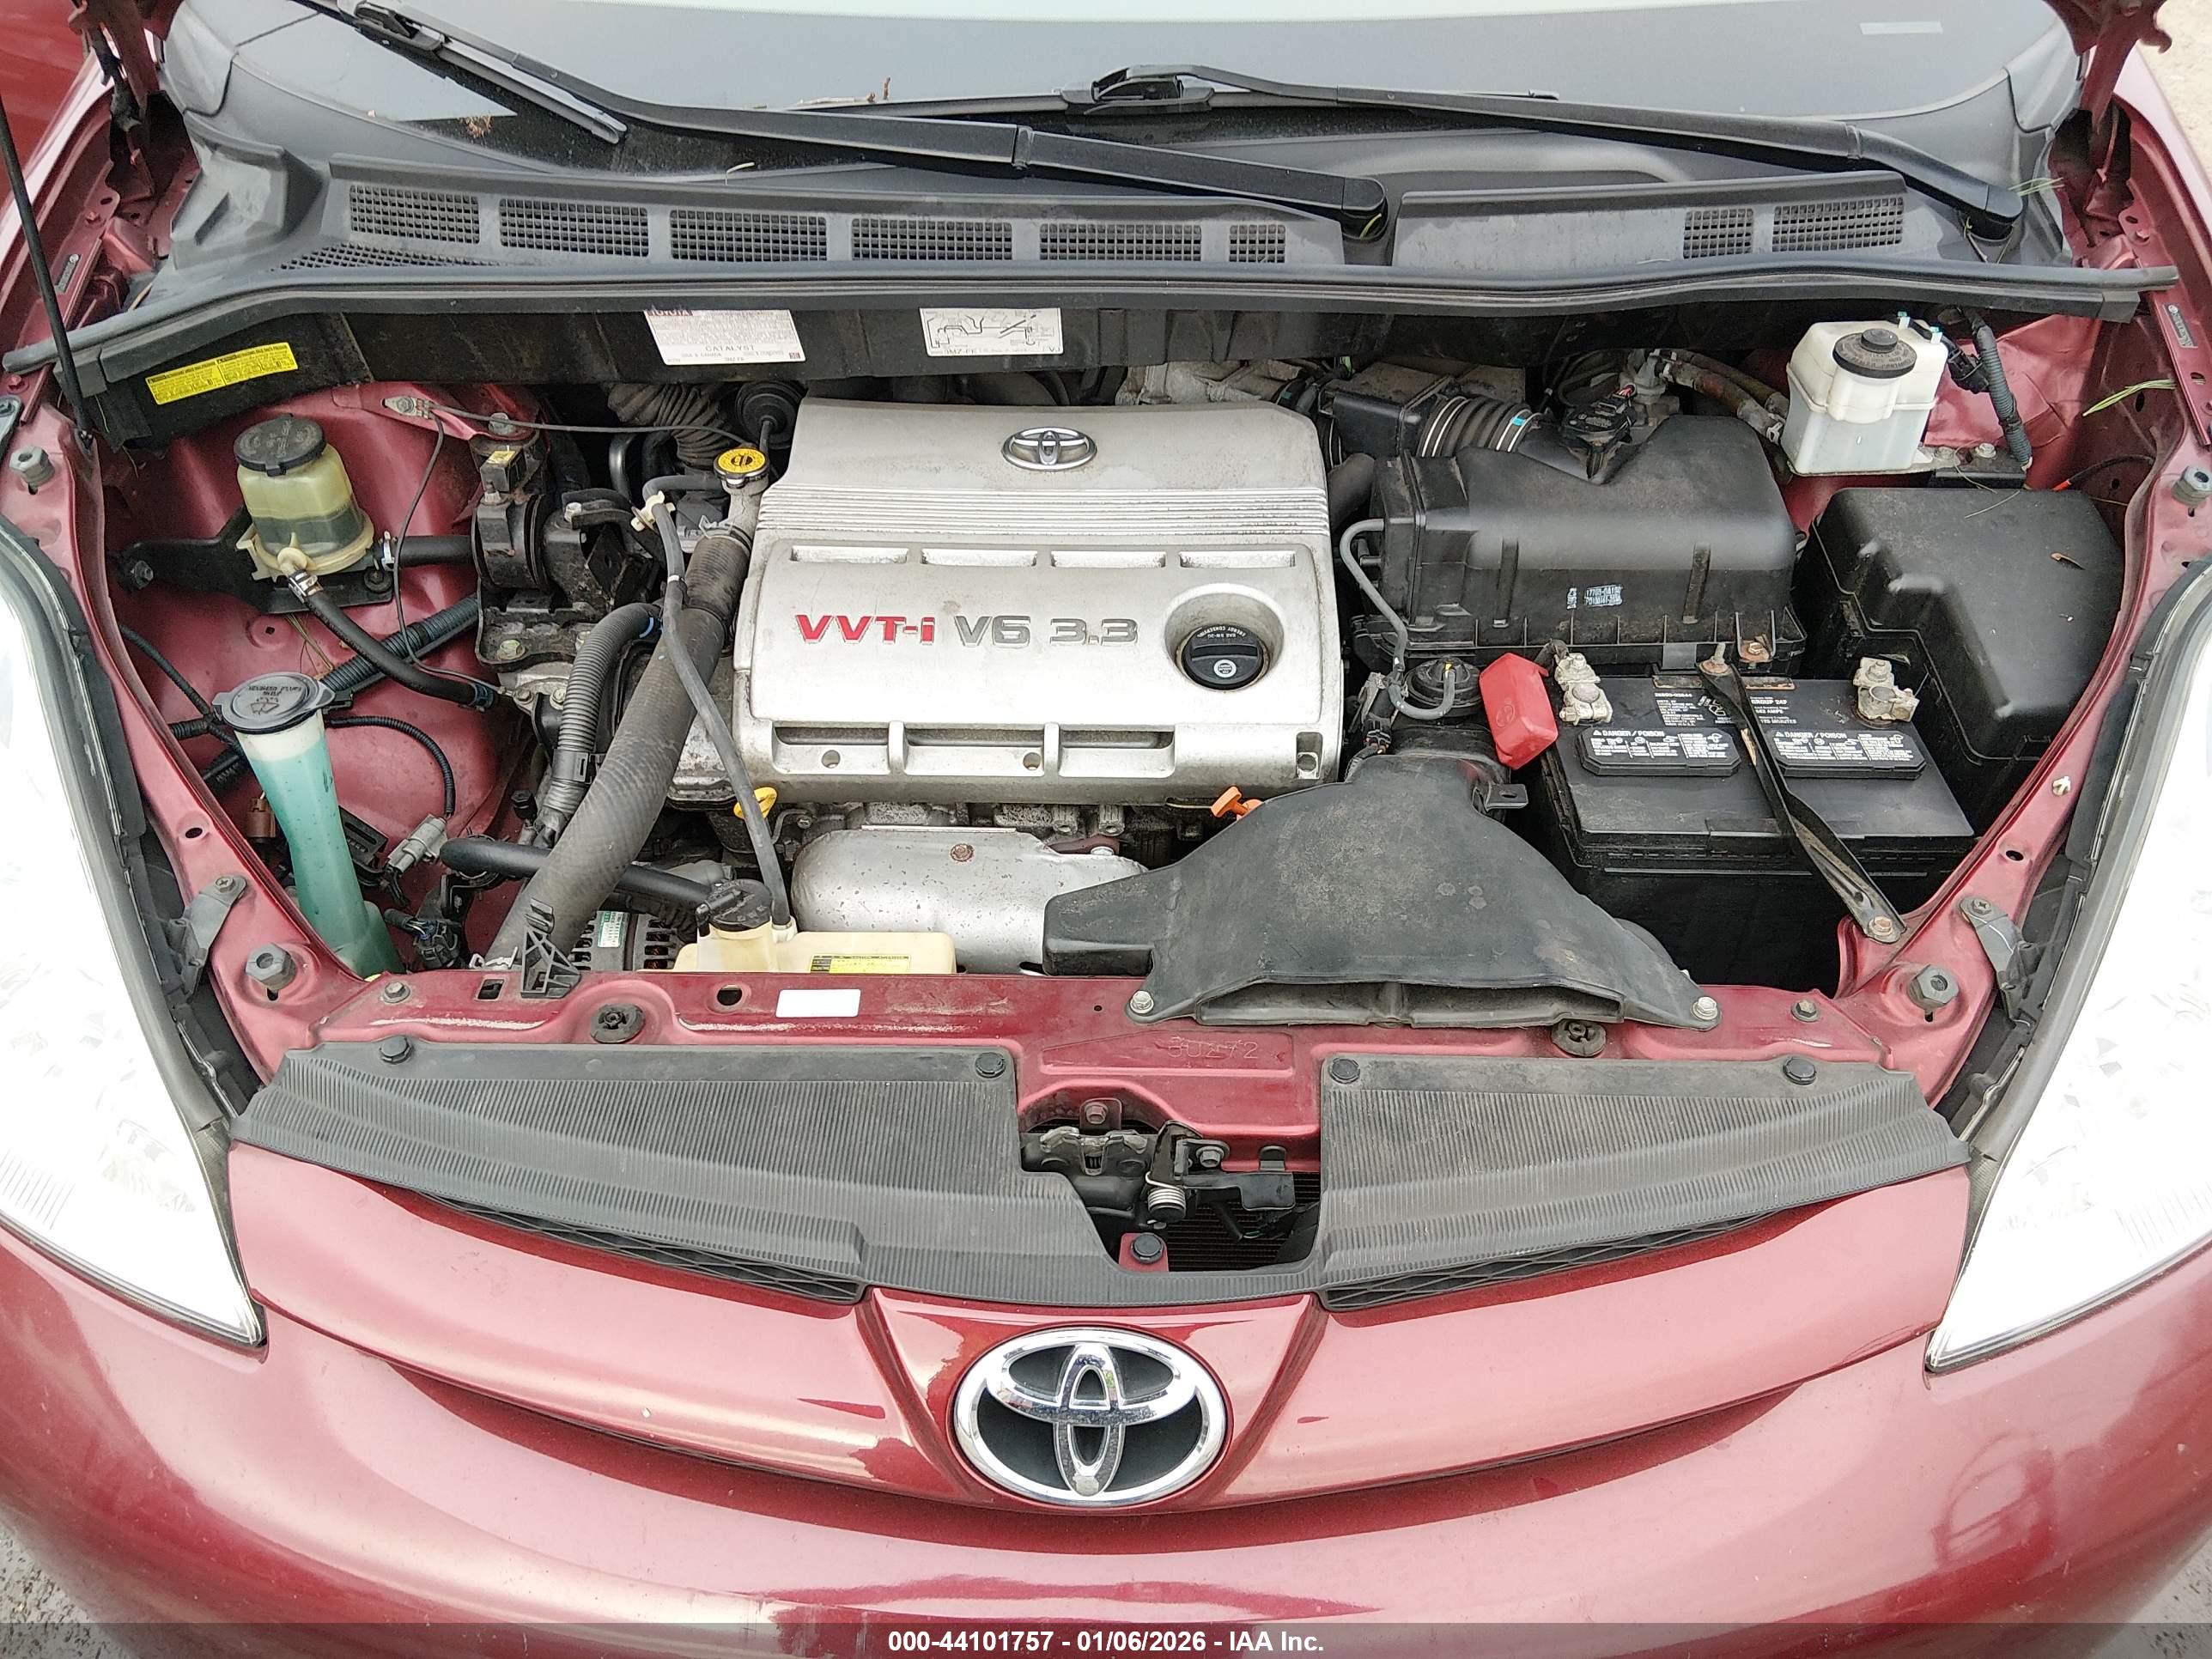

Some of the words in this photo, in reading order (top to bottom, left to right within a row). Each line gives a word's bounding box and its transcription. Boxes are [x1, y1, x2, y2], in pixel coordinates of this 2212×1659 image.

[795, 614, 936, 645] VVT-i
[954, 615, 1031, 647] V6
[1050, 617, 1139, 647] 3.3
